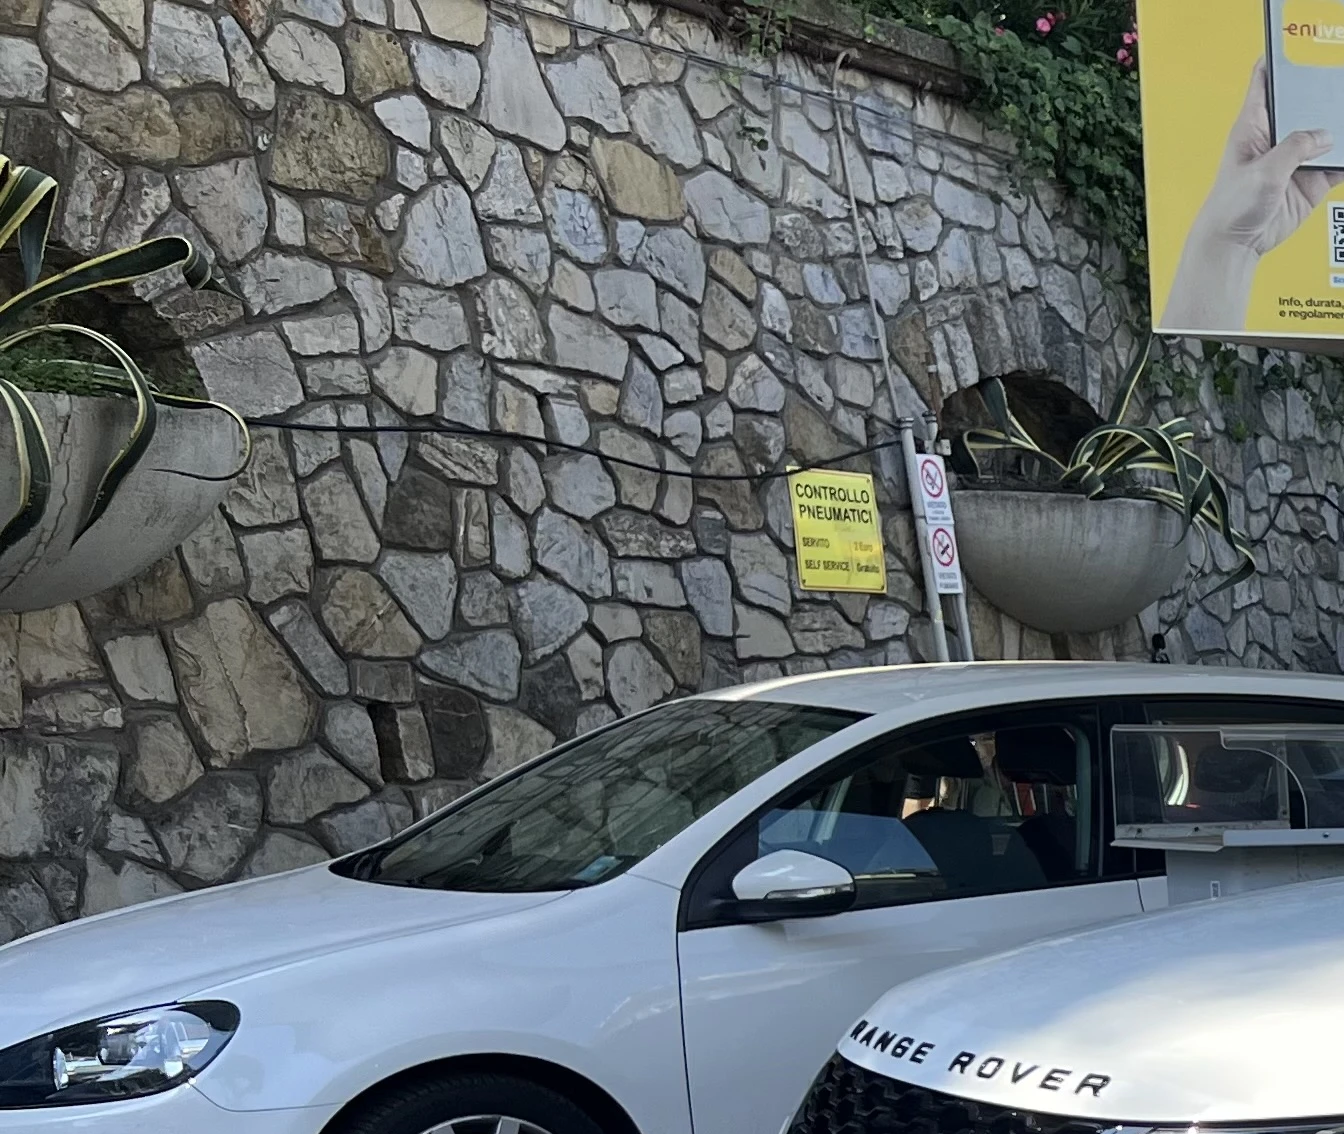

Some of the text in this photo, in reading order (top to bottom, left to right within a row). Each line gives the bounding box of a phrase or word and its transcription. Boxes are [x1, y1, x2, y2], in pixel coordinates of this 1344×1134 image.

[1278, 297, 1304, 309] Info,
[1305, 297, 1344, 310] durata,
[795, 483, 870, 504] CONTROLLO
[798, 504, 873, 524] PNEUMATICI
[804, 559, 821, 570] SELF
[822, 560, 850, 572] SERVICE
[850, 1020, 1111, 1097] RANGE ROVER
